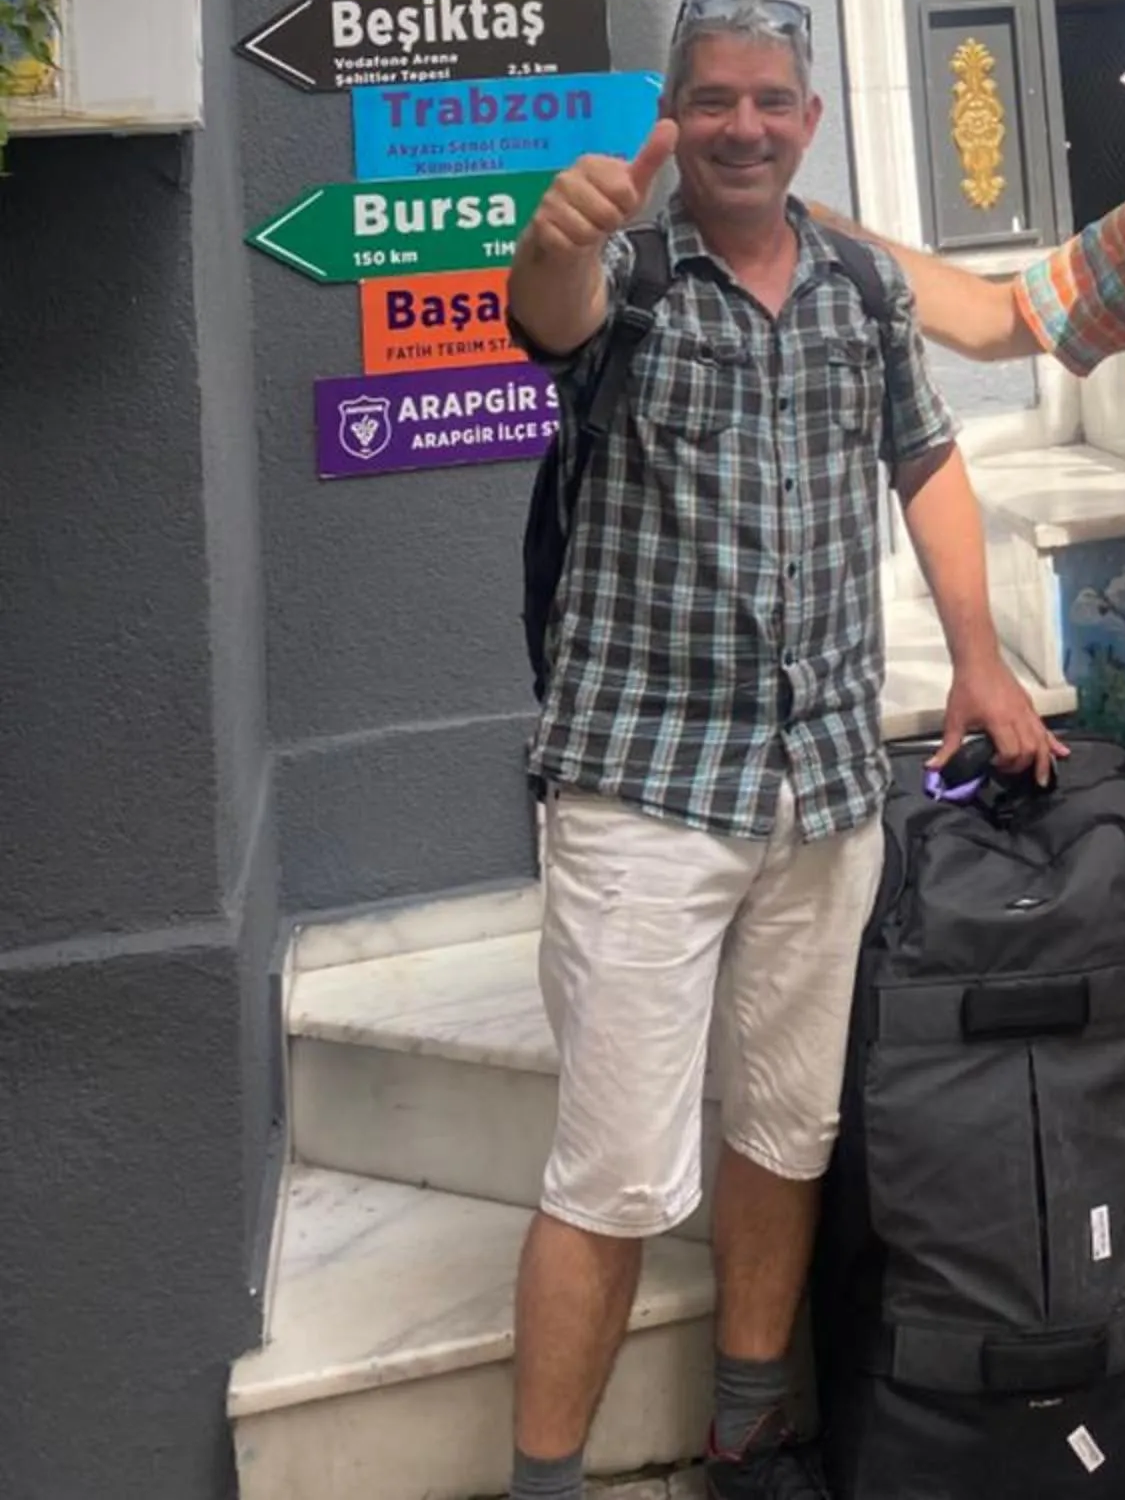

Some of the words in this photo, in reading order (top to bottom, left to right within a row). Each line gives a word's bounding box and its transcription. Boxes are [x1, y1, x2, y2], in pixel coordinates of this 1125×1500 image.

[333, 55, 409, 71] Vodafone
[412, 52, 458, 66] Arena
[534, 62, 558, 74] km
[401, 66, 450, 82] Tepesi
[381, 87, 592, 128] Trabzon
[353, 192, 516, 236] Bursa
[354, 252, 385, 266] 150
[390, 250, 418, 263] km
[387, 290, 500, 331] Başa
[490, 337, 513, 354] ST
[398, 382, 537, 423] ARAPGİR
[412, 424, 493, 450] ARAPGİR
[498, 421, 537, 443] İLÇE
